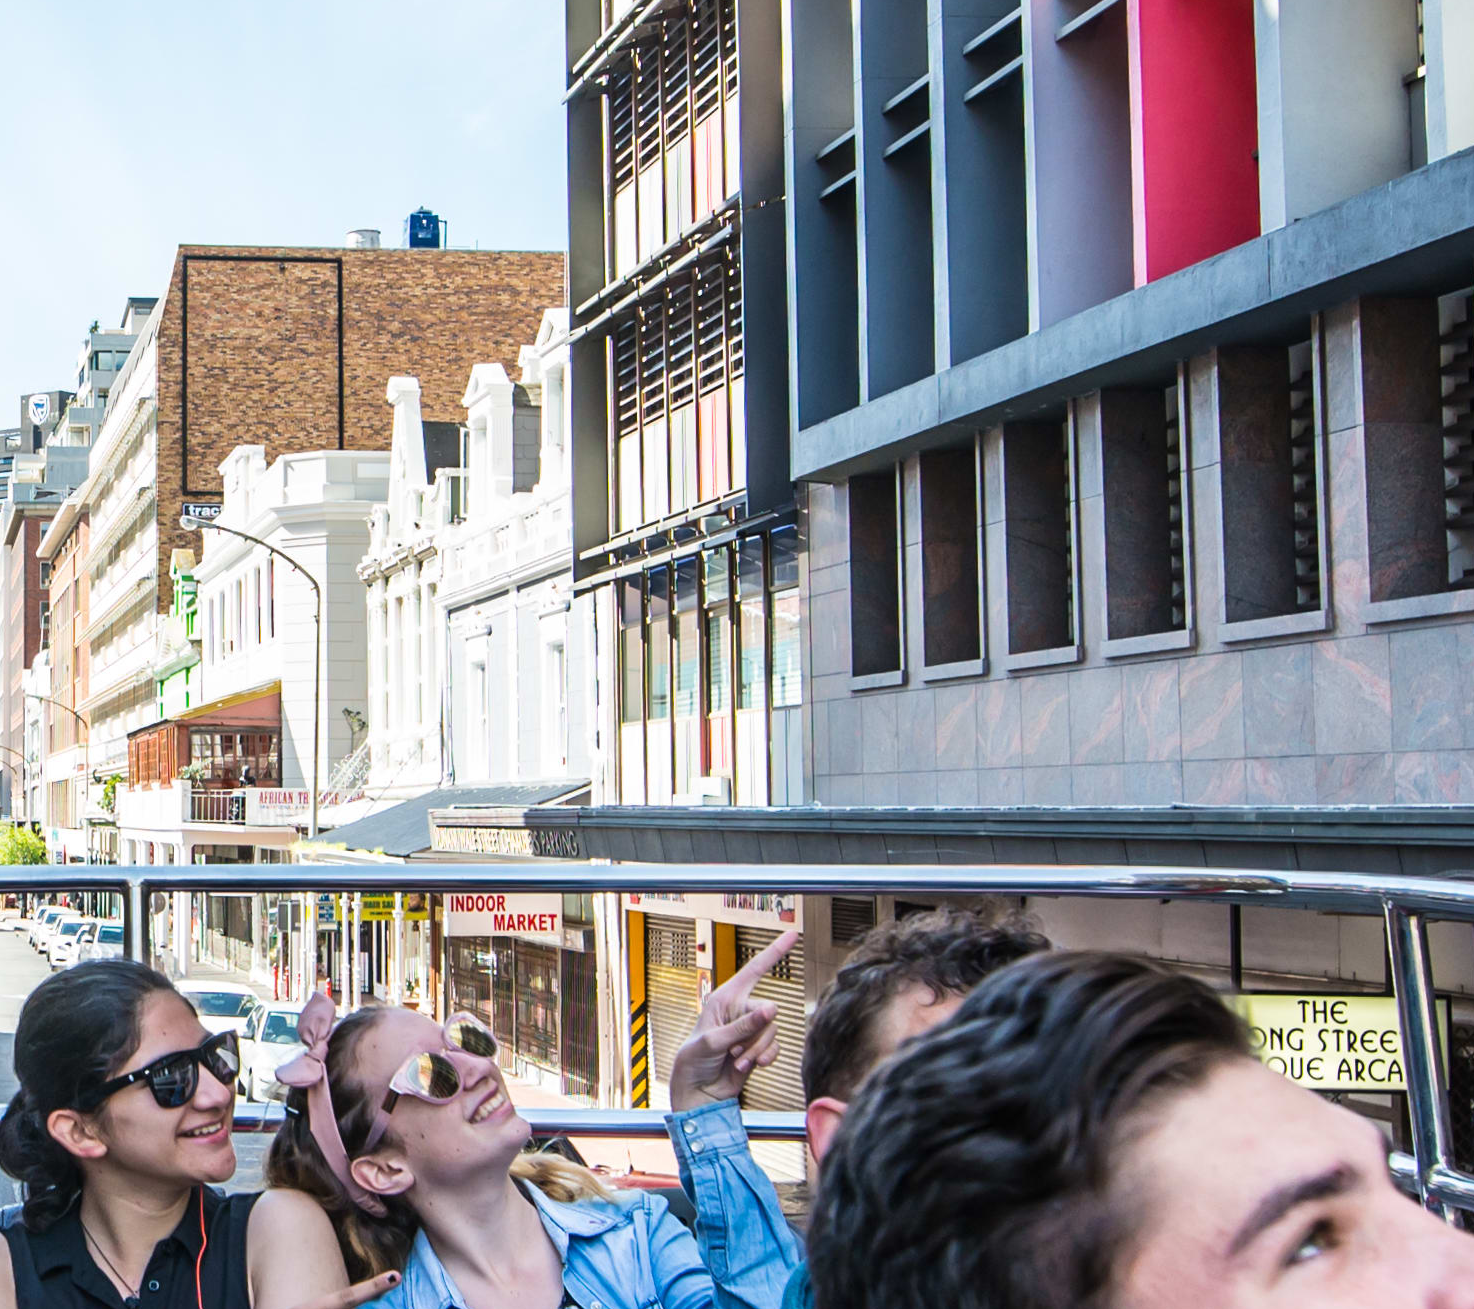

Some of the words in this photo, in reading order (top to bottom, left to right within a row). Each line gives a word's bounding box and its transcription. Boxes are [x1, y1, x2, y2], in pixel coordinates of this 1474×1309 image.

[541, 830, 579, 858] PARKING
[450, 895, 506, 912] INDOOR
[494, 913, 558, 931] MARKET
[1297, 999, 1349, 1024] THE
[1247, 1026, 1304, 1051] ONG
[1317, 1028, 1398, 1054] STREE
[1336, 1057, 1404, 1083] ARCA
